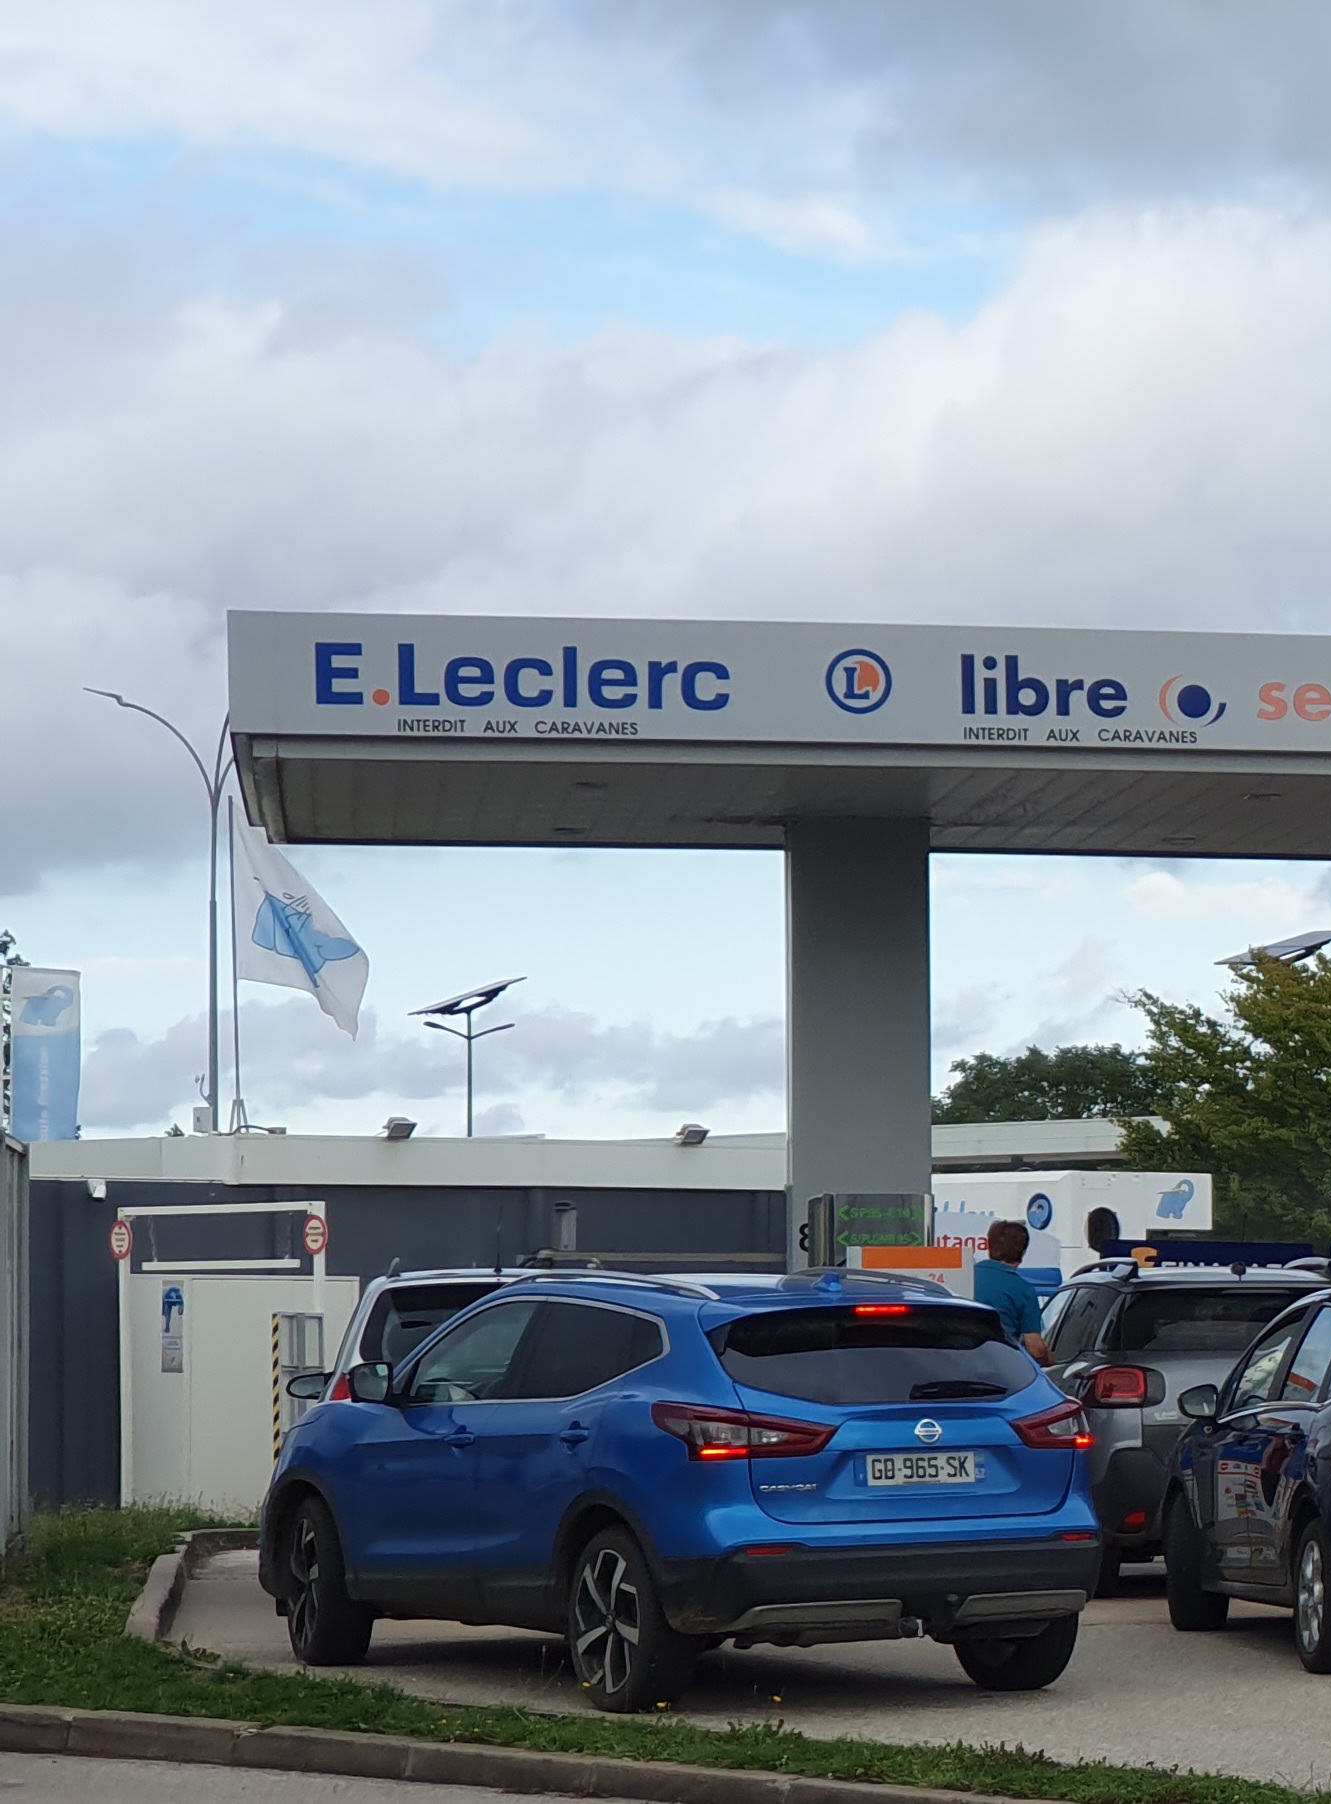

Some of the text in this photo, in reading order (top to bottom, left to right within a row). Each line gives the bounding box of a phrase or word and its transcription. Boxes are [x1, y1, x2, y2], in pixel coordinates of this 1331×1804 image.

[315, 642, 730, 711] E.Leclerc
[961, 654, 1128, 718] libre
[397, 718, 639, 736] INTERDIT AUX CARAVANES
[963, 727, 1198, 744] INTERDIT AUX CARAVANES
